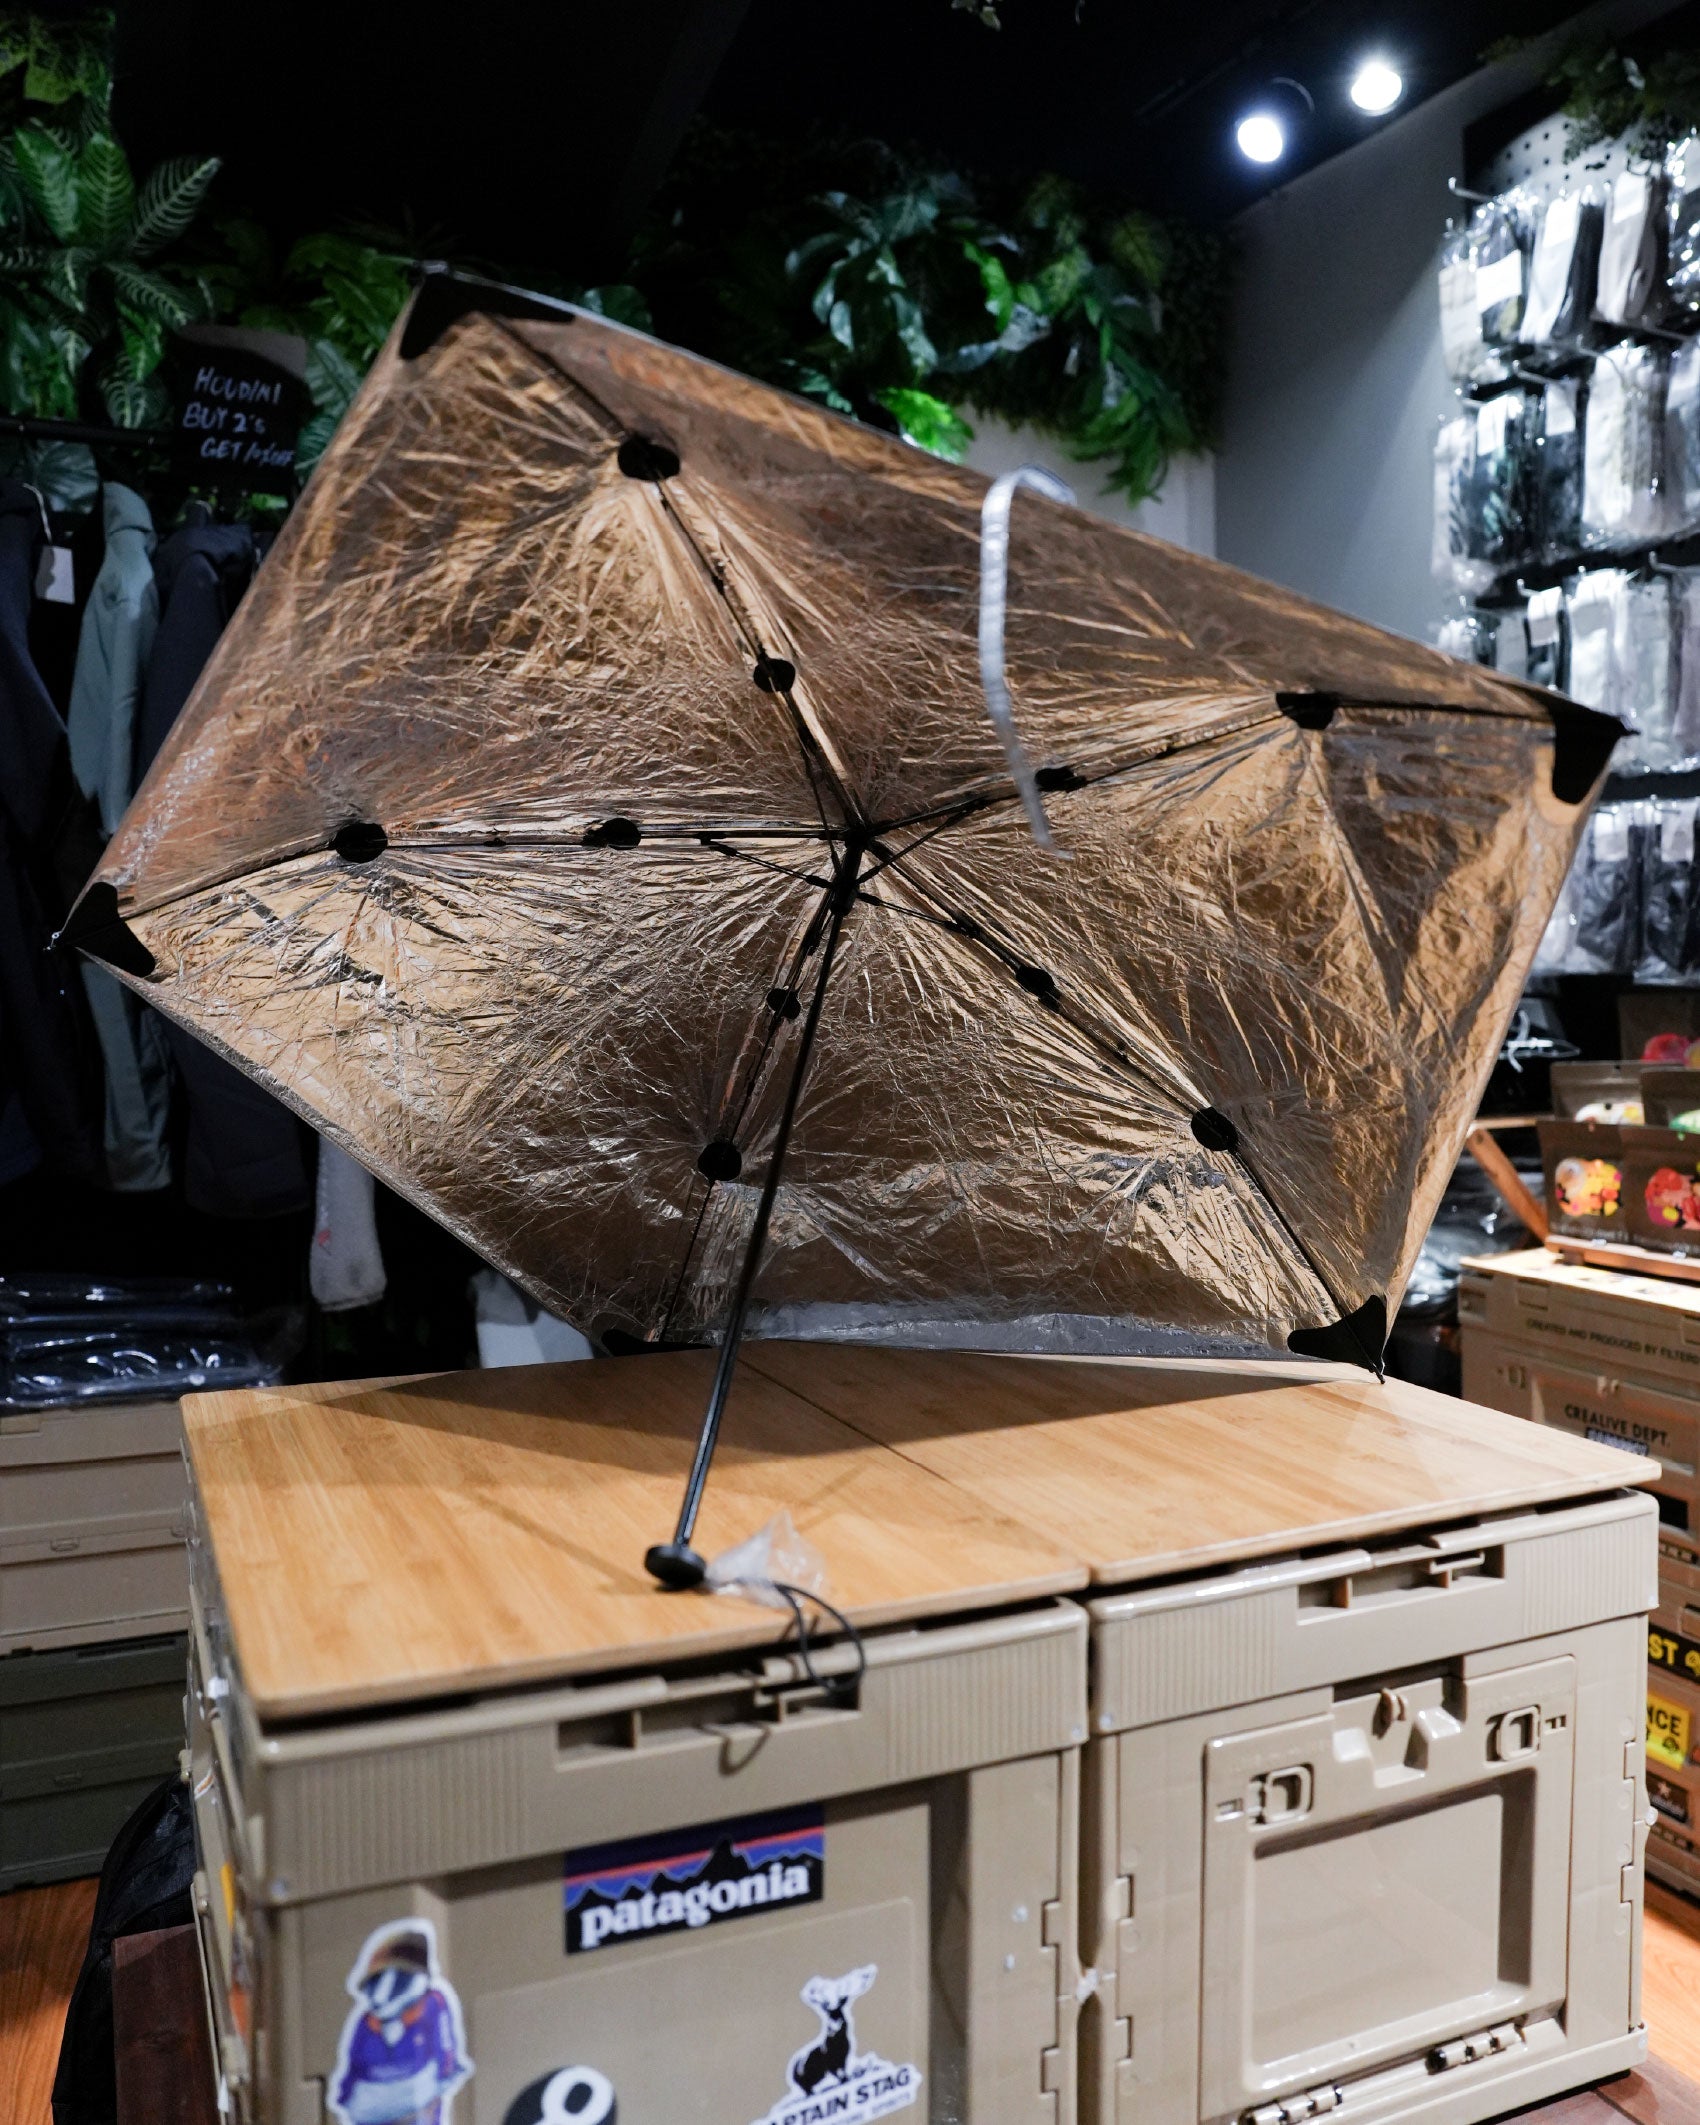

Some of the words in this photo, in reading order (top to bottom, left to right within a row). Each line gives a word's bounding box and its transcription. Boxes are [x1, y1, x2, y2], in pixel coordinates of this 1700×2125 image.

[183, 402, 228, 430] BUY
[200, 437, 242, 460] GET
[580, 1861, 809, 1949] patagonia
[857, 2067, 910, 2105] STAG
